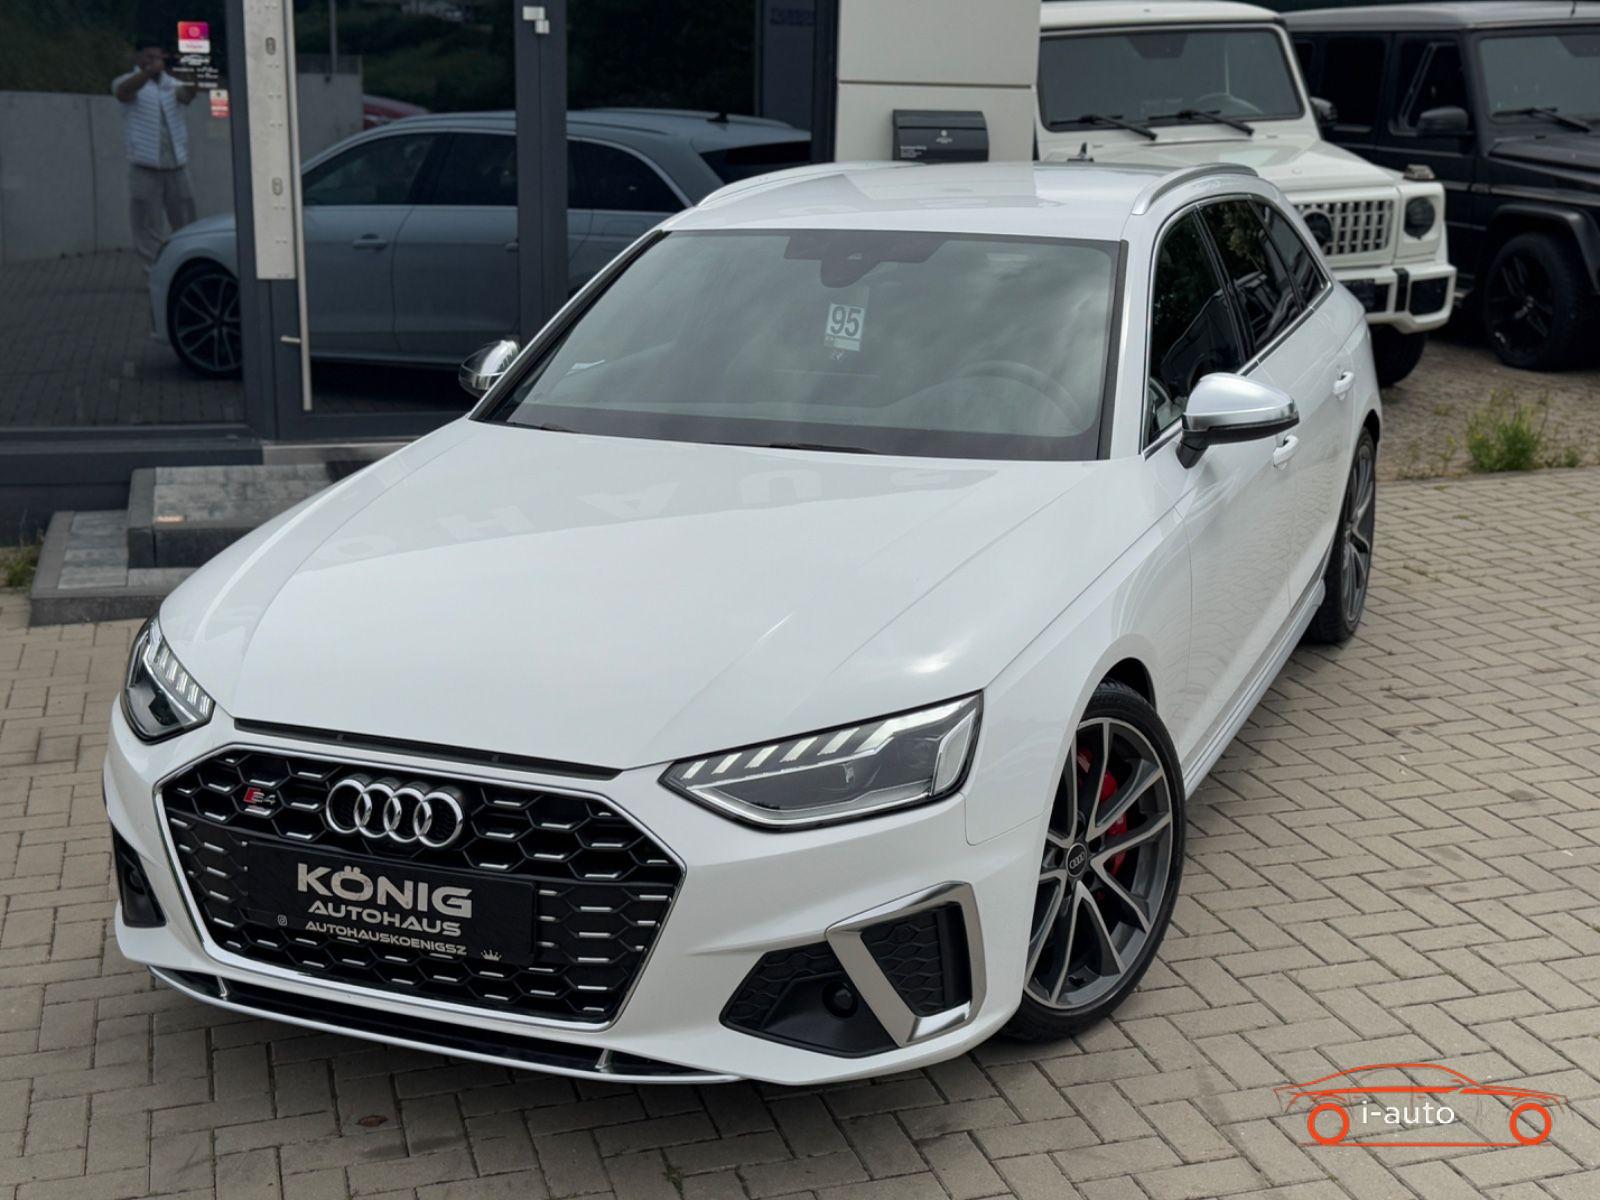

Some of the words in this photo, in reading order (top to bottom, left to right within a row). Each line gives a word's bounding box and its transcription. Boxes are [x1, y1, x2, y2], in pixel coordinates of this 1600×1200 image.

[830, 305, 861, 336] 95
[297, 863, 473, 918] KÖNIG
[308, 900, 462, 937] AUTOHAUS
[305, 920, 467, 955] AUTOHAUSKOENIGSZ
